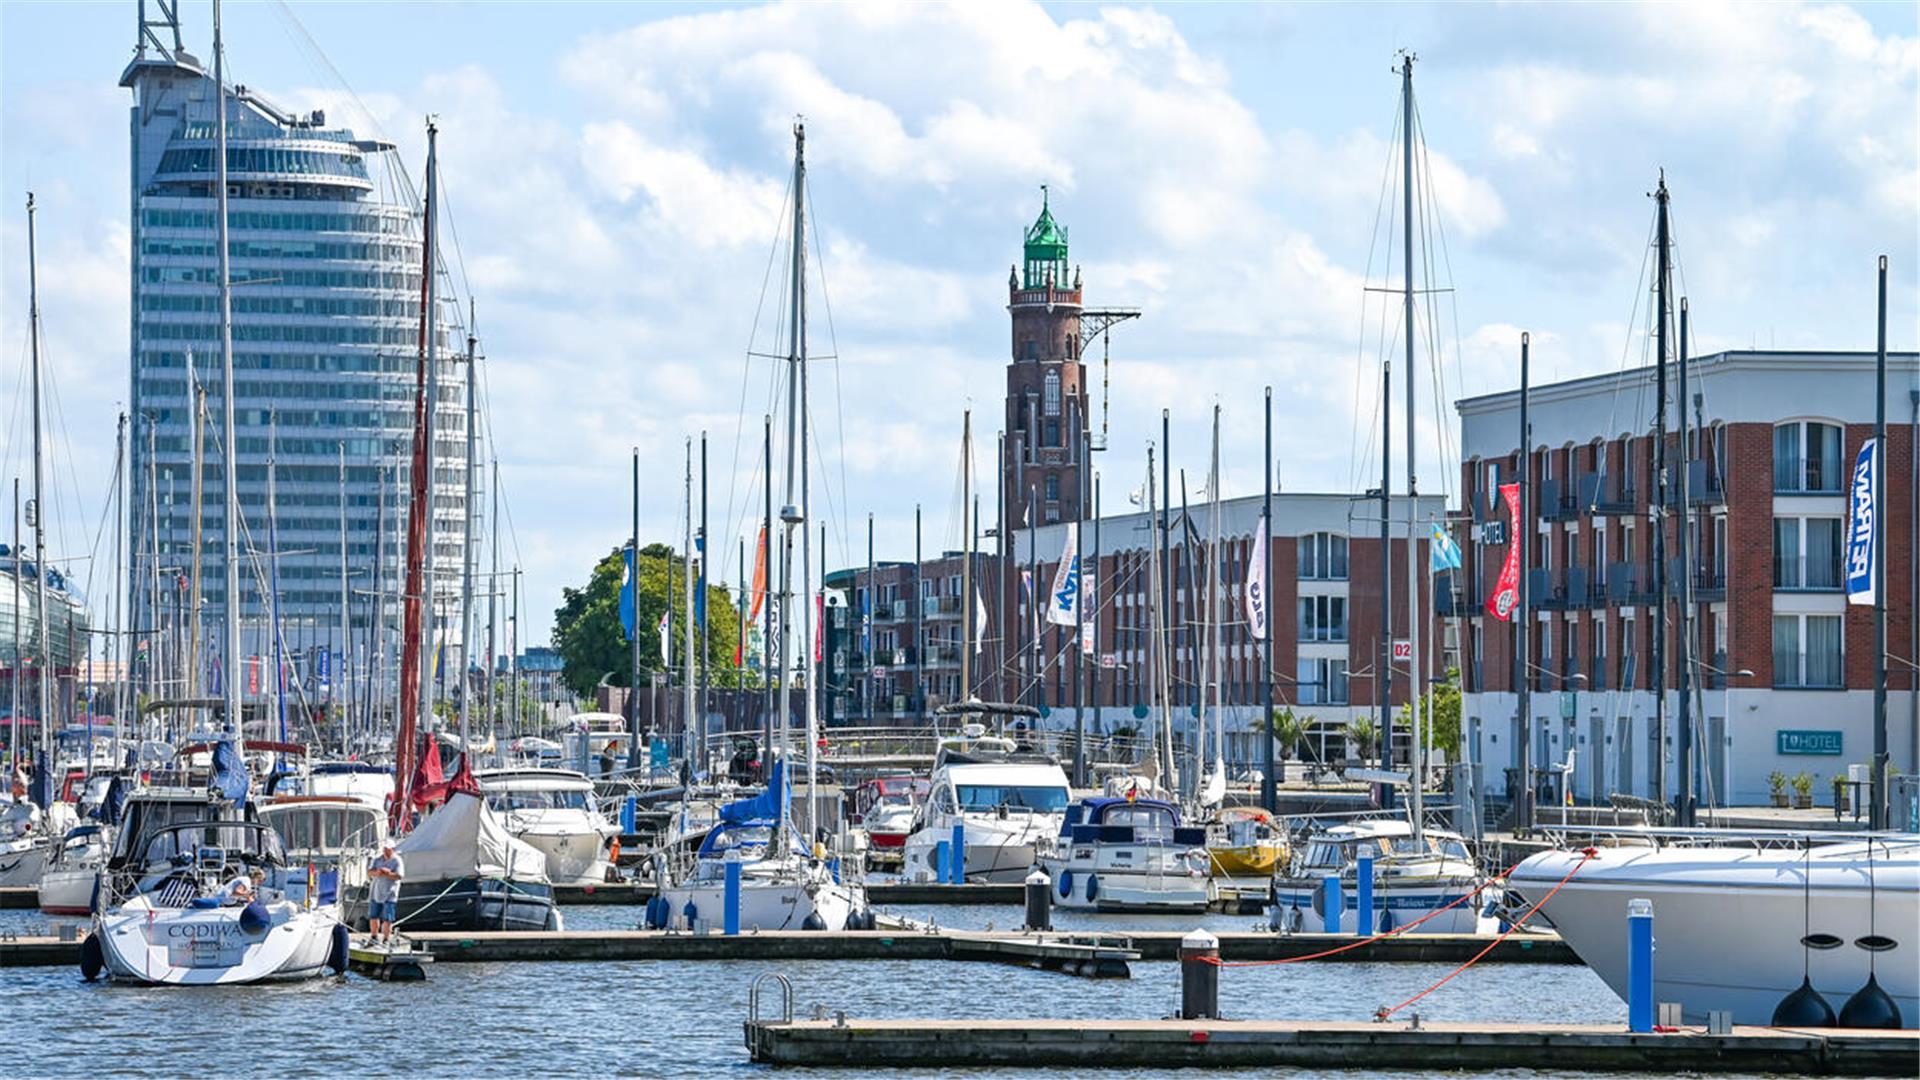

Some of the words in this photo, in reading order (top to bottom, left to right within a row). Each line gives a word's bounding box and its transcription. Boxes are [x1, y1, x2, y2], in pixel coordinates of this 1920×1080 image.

[1395, 644, 1410, 657] D2
[1799, 735, 1840, 748] HOTEL
[168, 923, 242, 938] CODIWA
